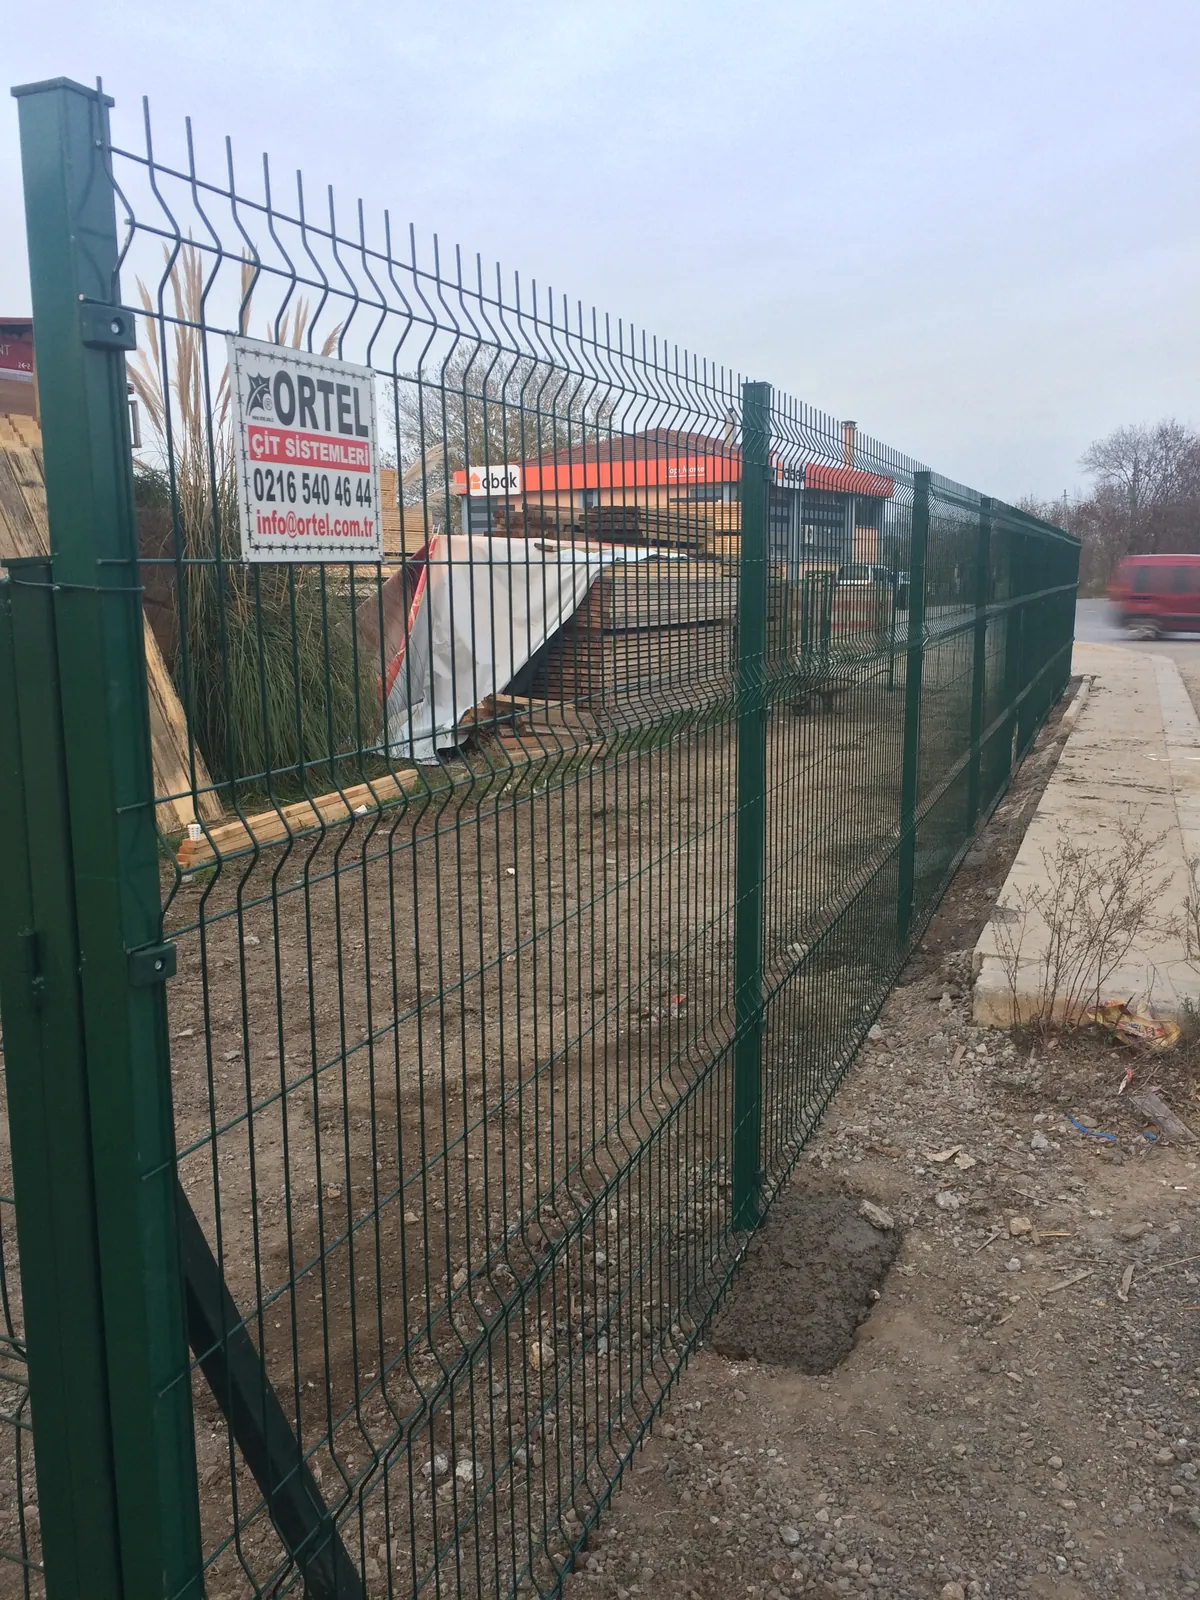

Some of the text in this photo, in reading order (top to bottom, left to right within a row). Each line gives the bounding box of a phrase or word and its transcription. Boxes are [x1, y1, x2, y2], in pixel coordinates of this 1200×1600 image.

[273, 370, 369, 438] ORTEL
[251, 430, 369, 466] ÇİT SİSTEMLERİ
[253, 468, 372, 508] 0216 540 46 44
[256, 509, 374, 539] info@ortel.com.tr
